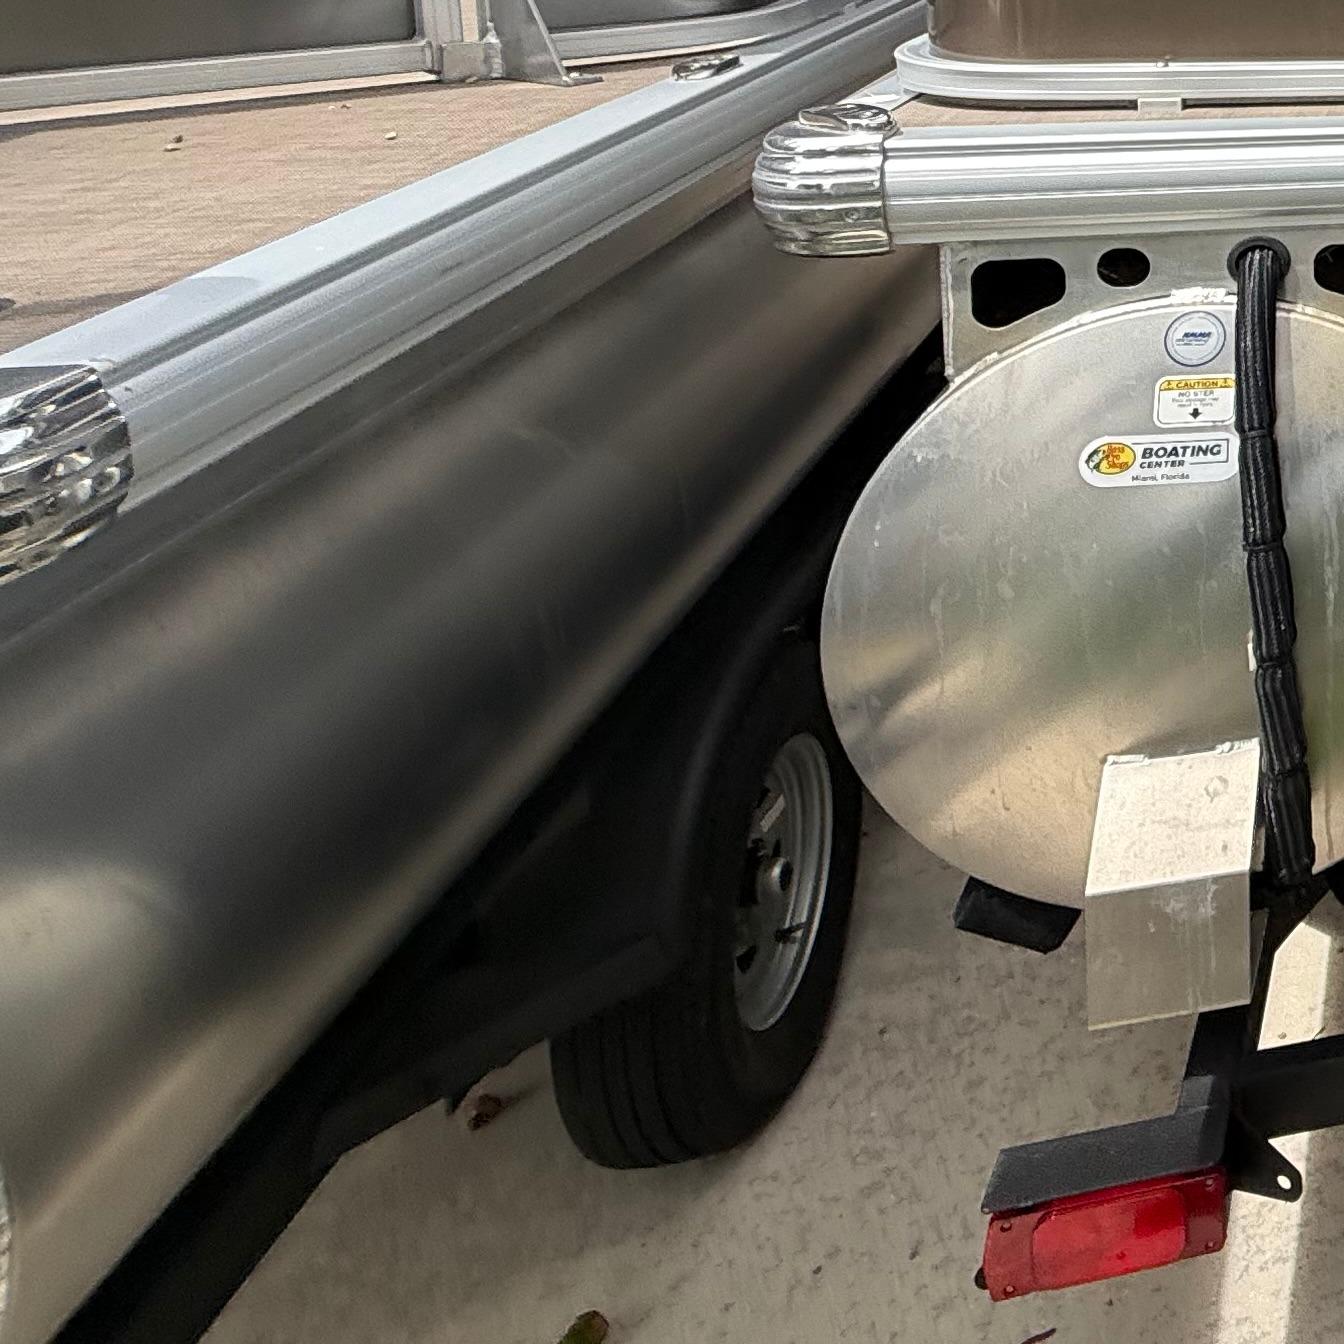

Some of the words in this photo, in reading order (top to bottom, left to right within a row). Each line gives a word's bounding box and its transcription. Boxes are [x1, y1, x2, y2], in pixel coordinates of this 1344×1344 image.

[1176, 380, 1219, 389] CAUTION
[1141, 444, 1222, 459] BOATING
[1140, 460, 1185, 469] CENTER
